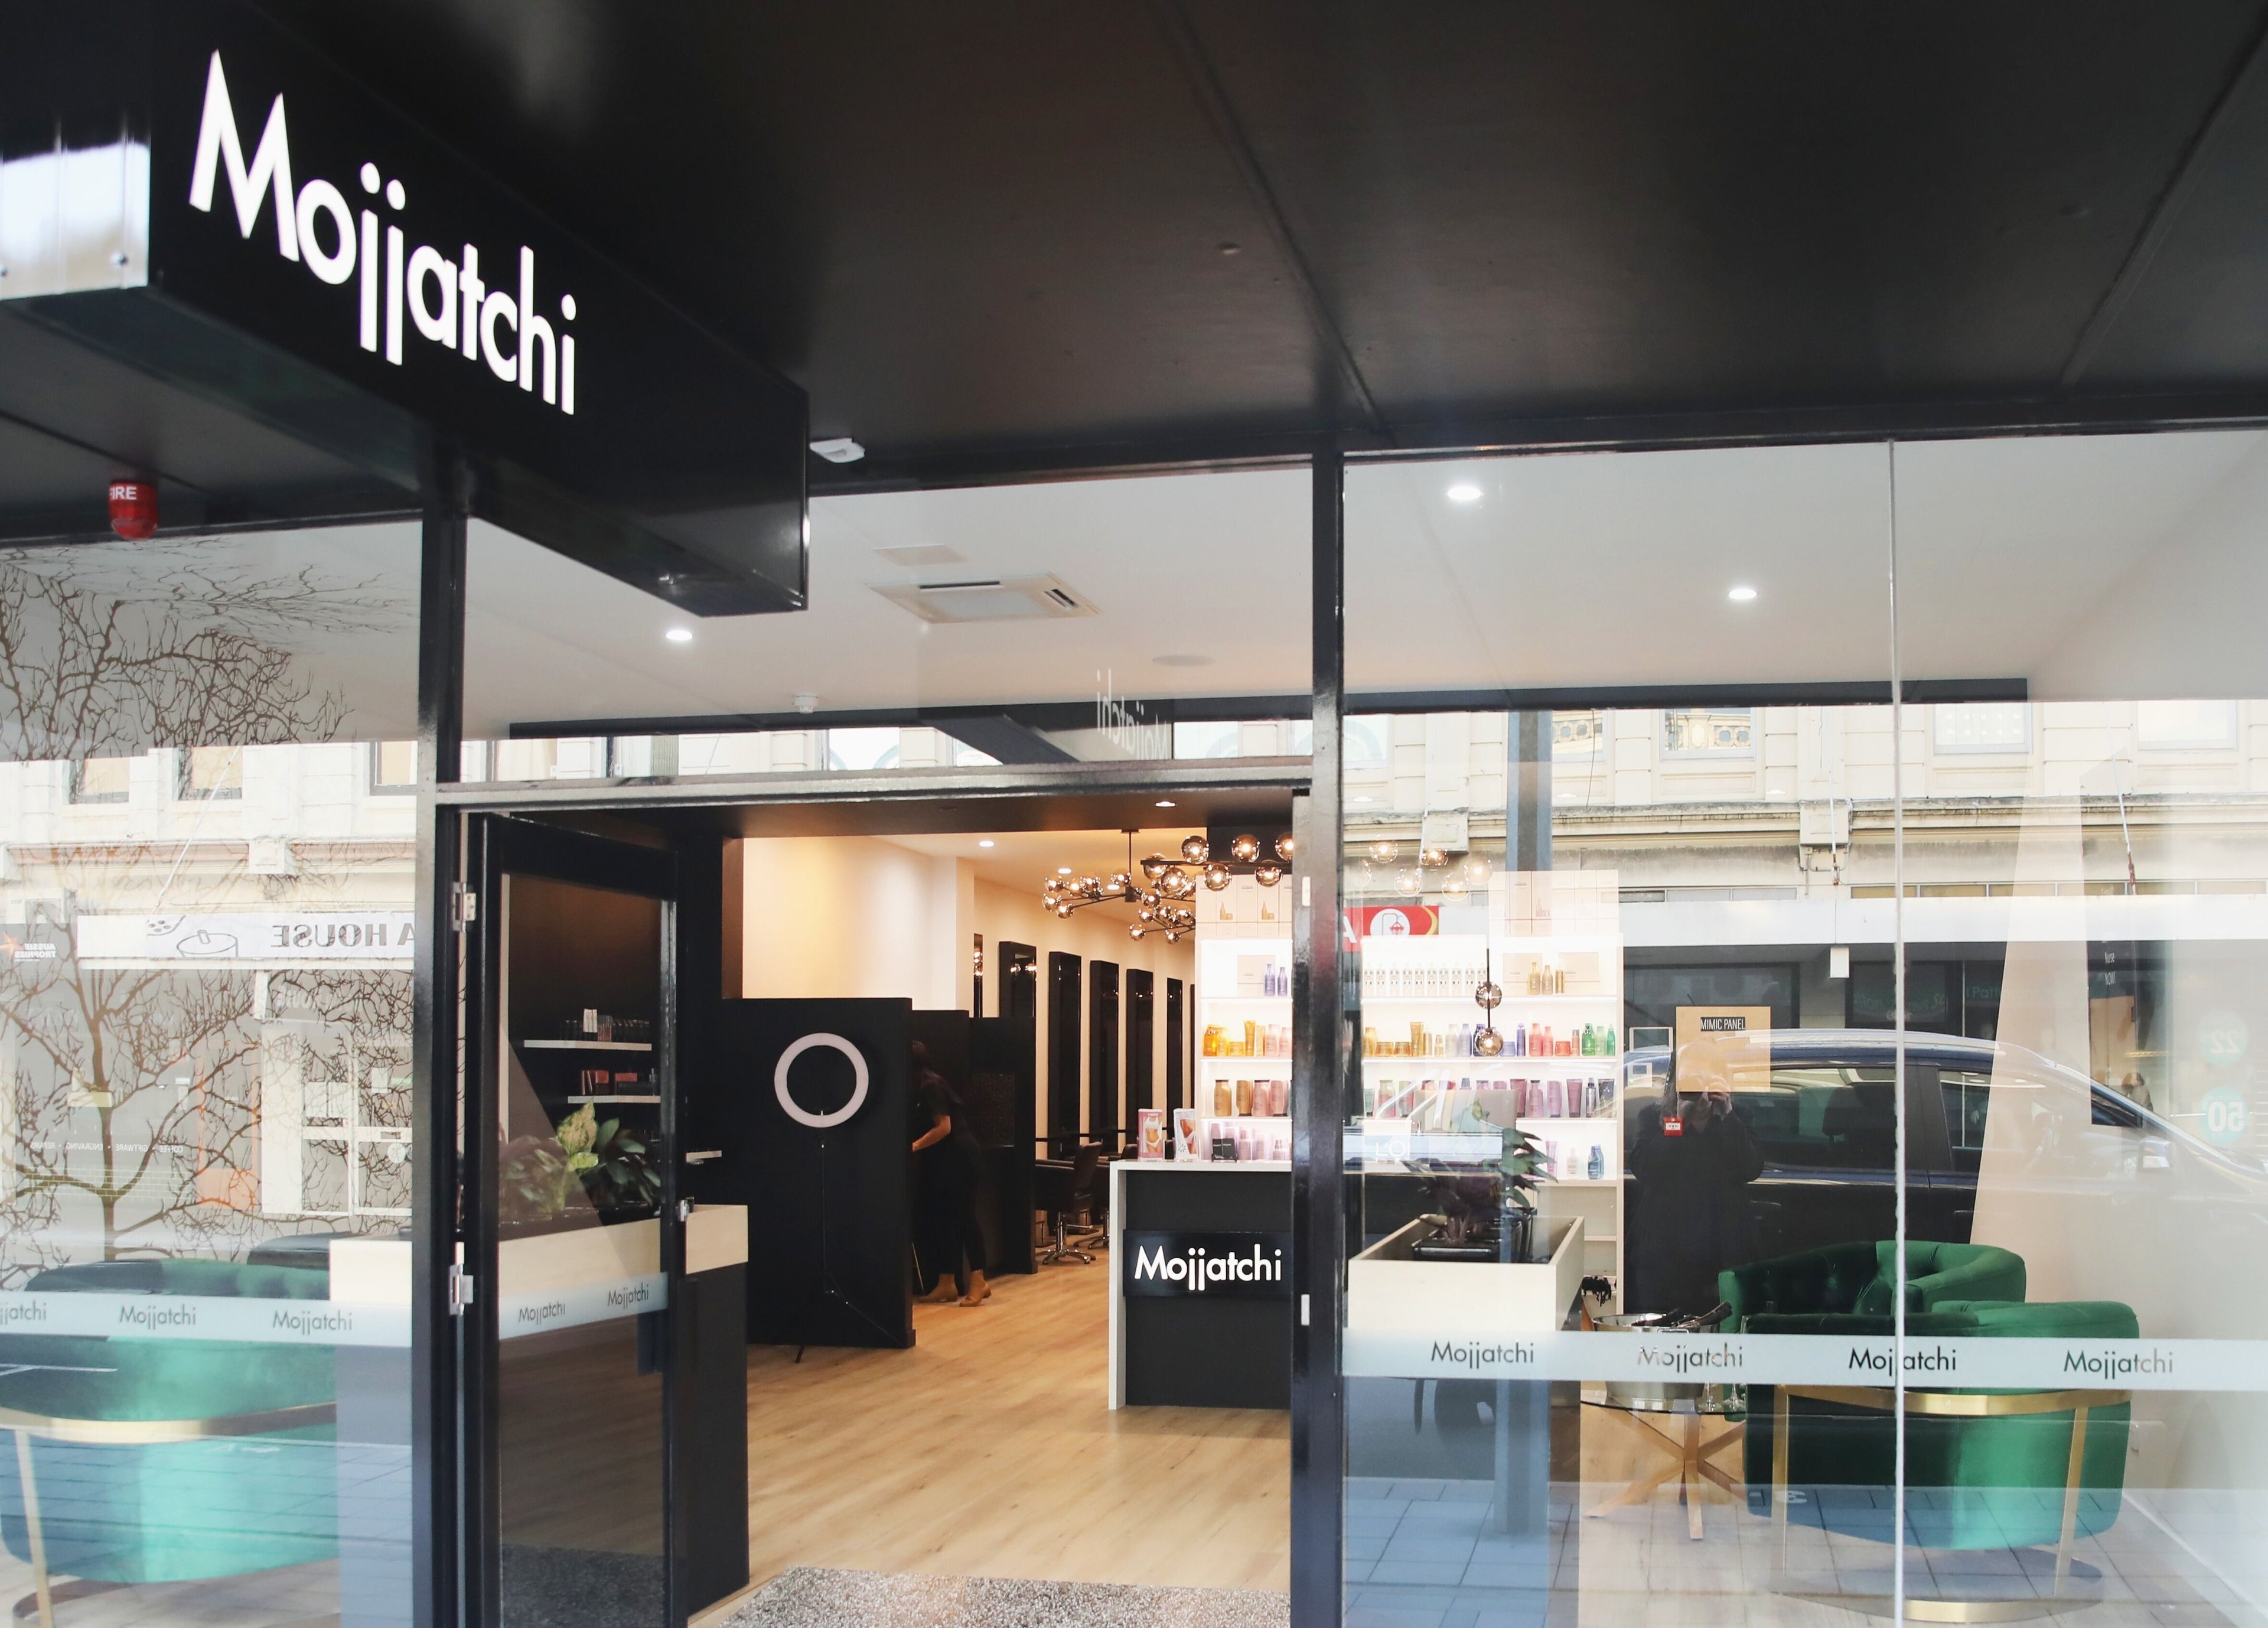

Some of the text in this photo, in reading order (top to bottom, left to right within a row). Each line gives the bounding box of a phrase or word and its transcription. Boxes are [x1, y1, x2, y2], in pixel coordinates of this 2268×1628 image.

[189, 48, 577, 415] Mojjatchi
[1700, 1018, 1745, 1030] MIMIC PANEL
[1134, 1243, 1282, 1291] Mojjatchi
[119, 1305, 197, 1330] Mojjatchi
[272, 1310, 353, 1336] Mojjatchi
[518, 1282, 649, 1325] Mojjatchi Mojjatchi
[1430, 1340, 2174, 1380] Mojjatchi Mojjatchi Mojatchi Mojjatchi
